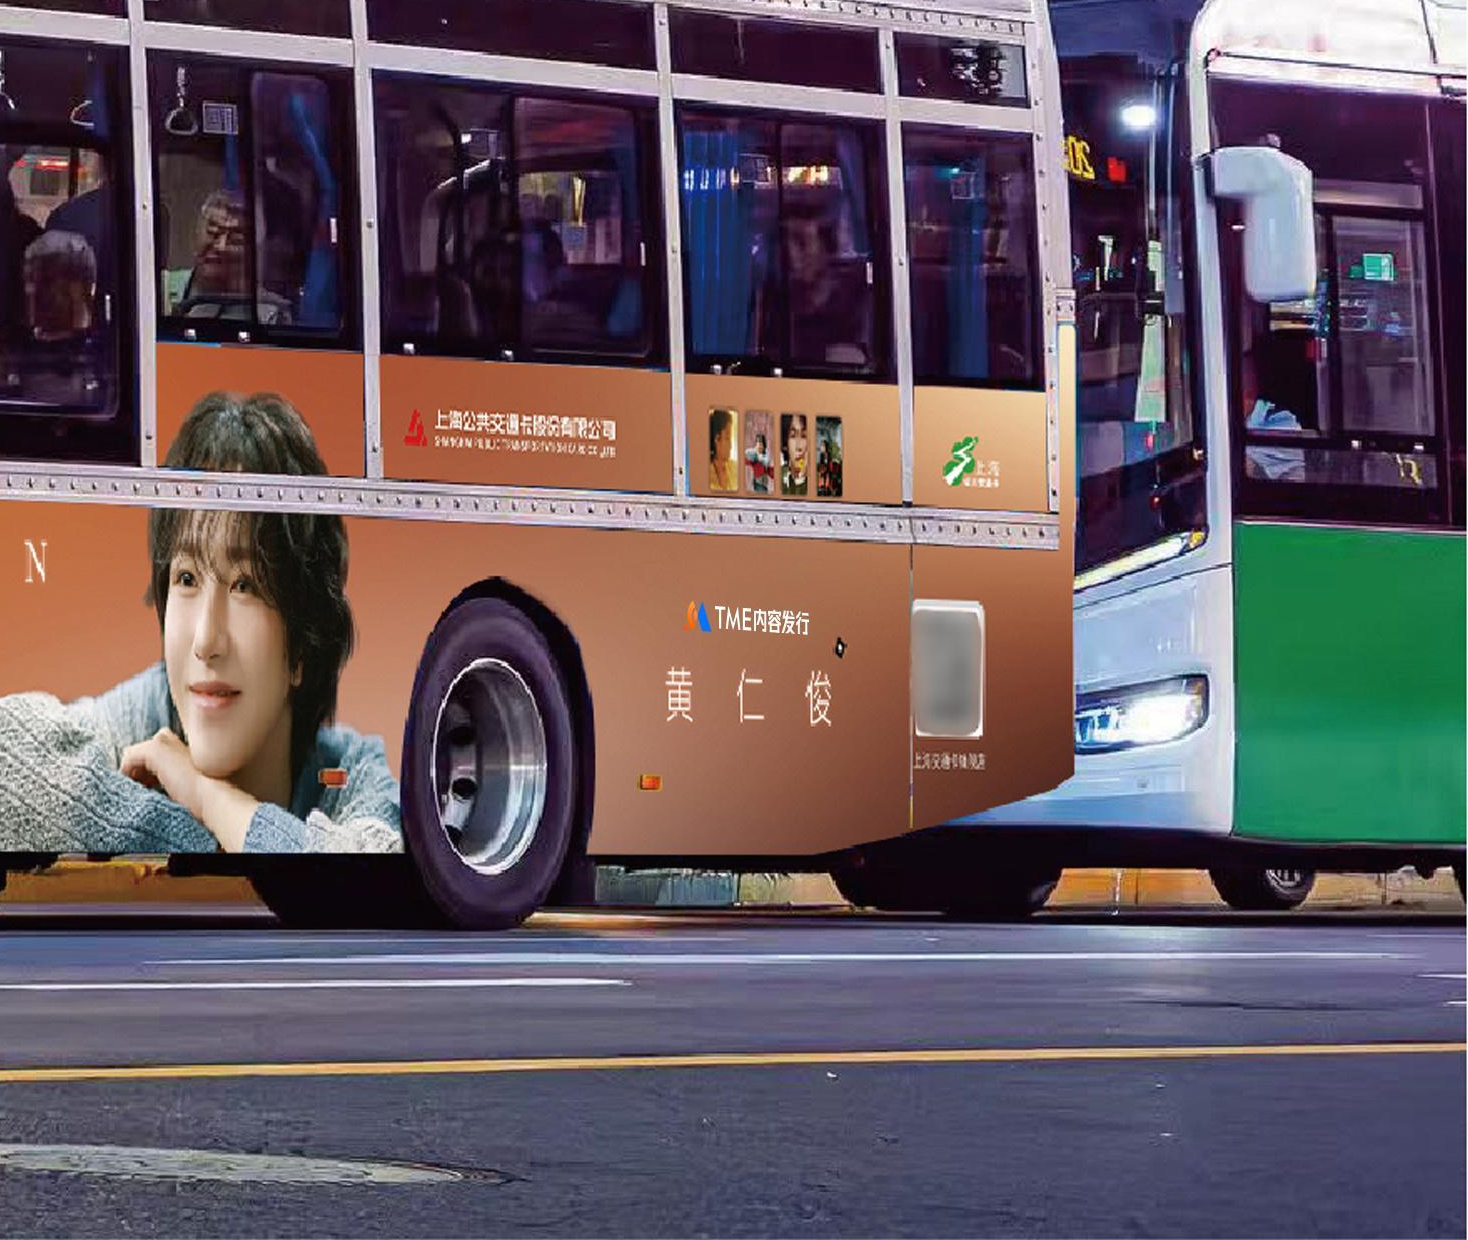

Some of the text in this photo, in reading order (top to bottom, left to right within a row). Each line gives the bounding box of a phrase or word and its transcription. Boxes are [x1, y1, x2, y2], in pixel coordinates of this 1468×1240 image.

[434, 409, 617, 441] 上海公共交通卡股份有限公司
[715, 605, 810, 636] TME内容发行
[665, 666, 832, 727] 黄仁俊
